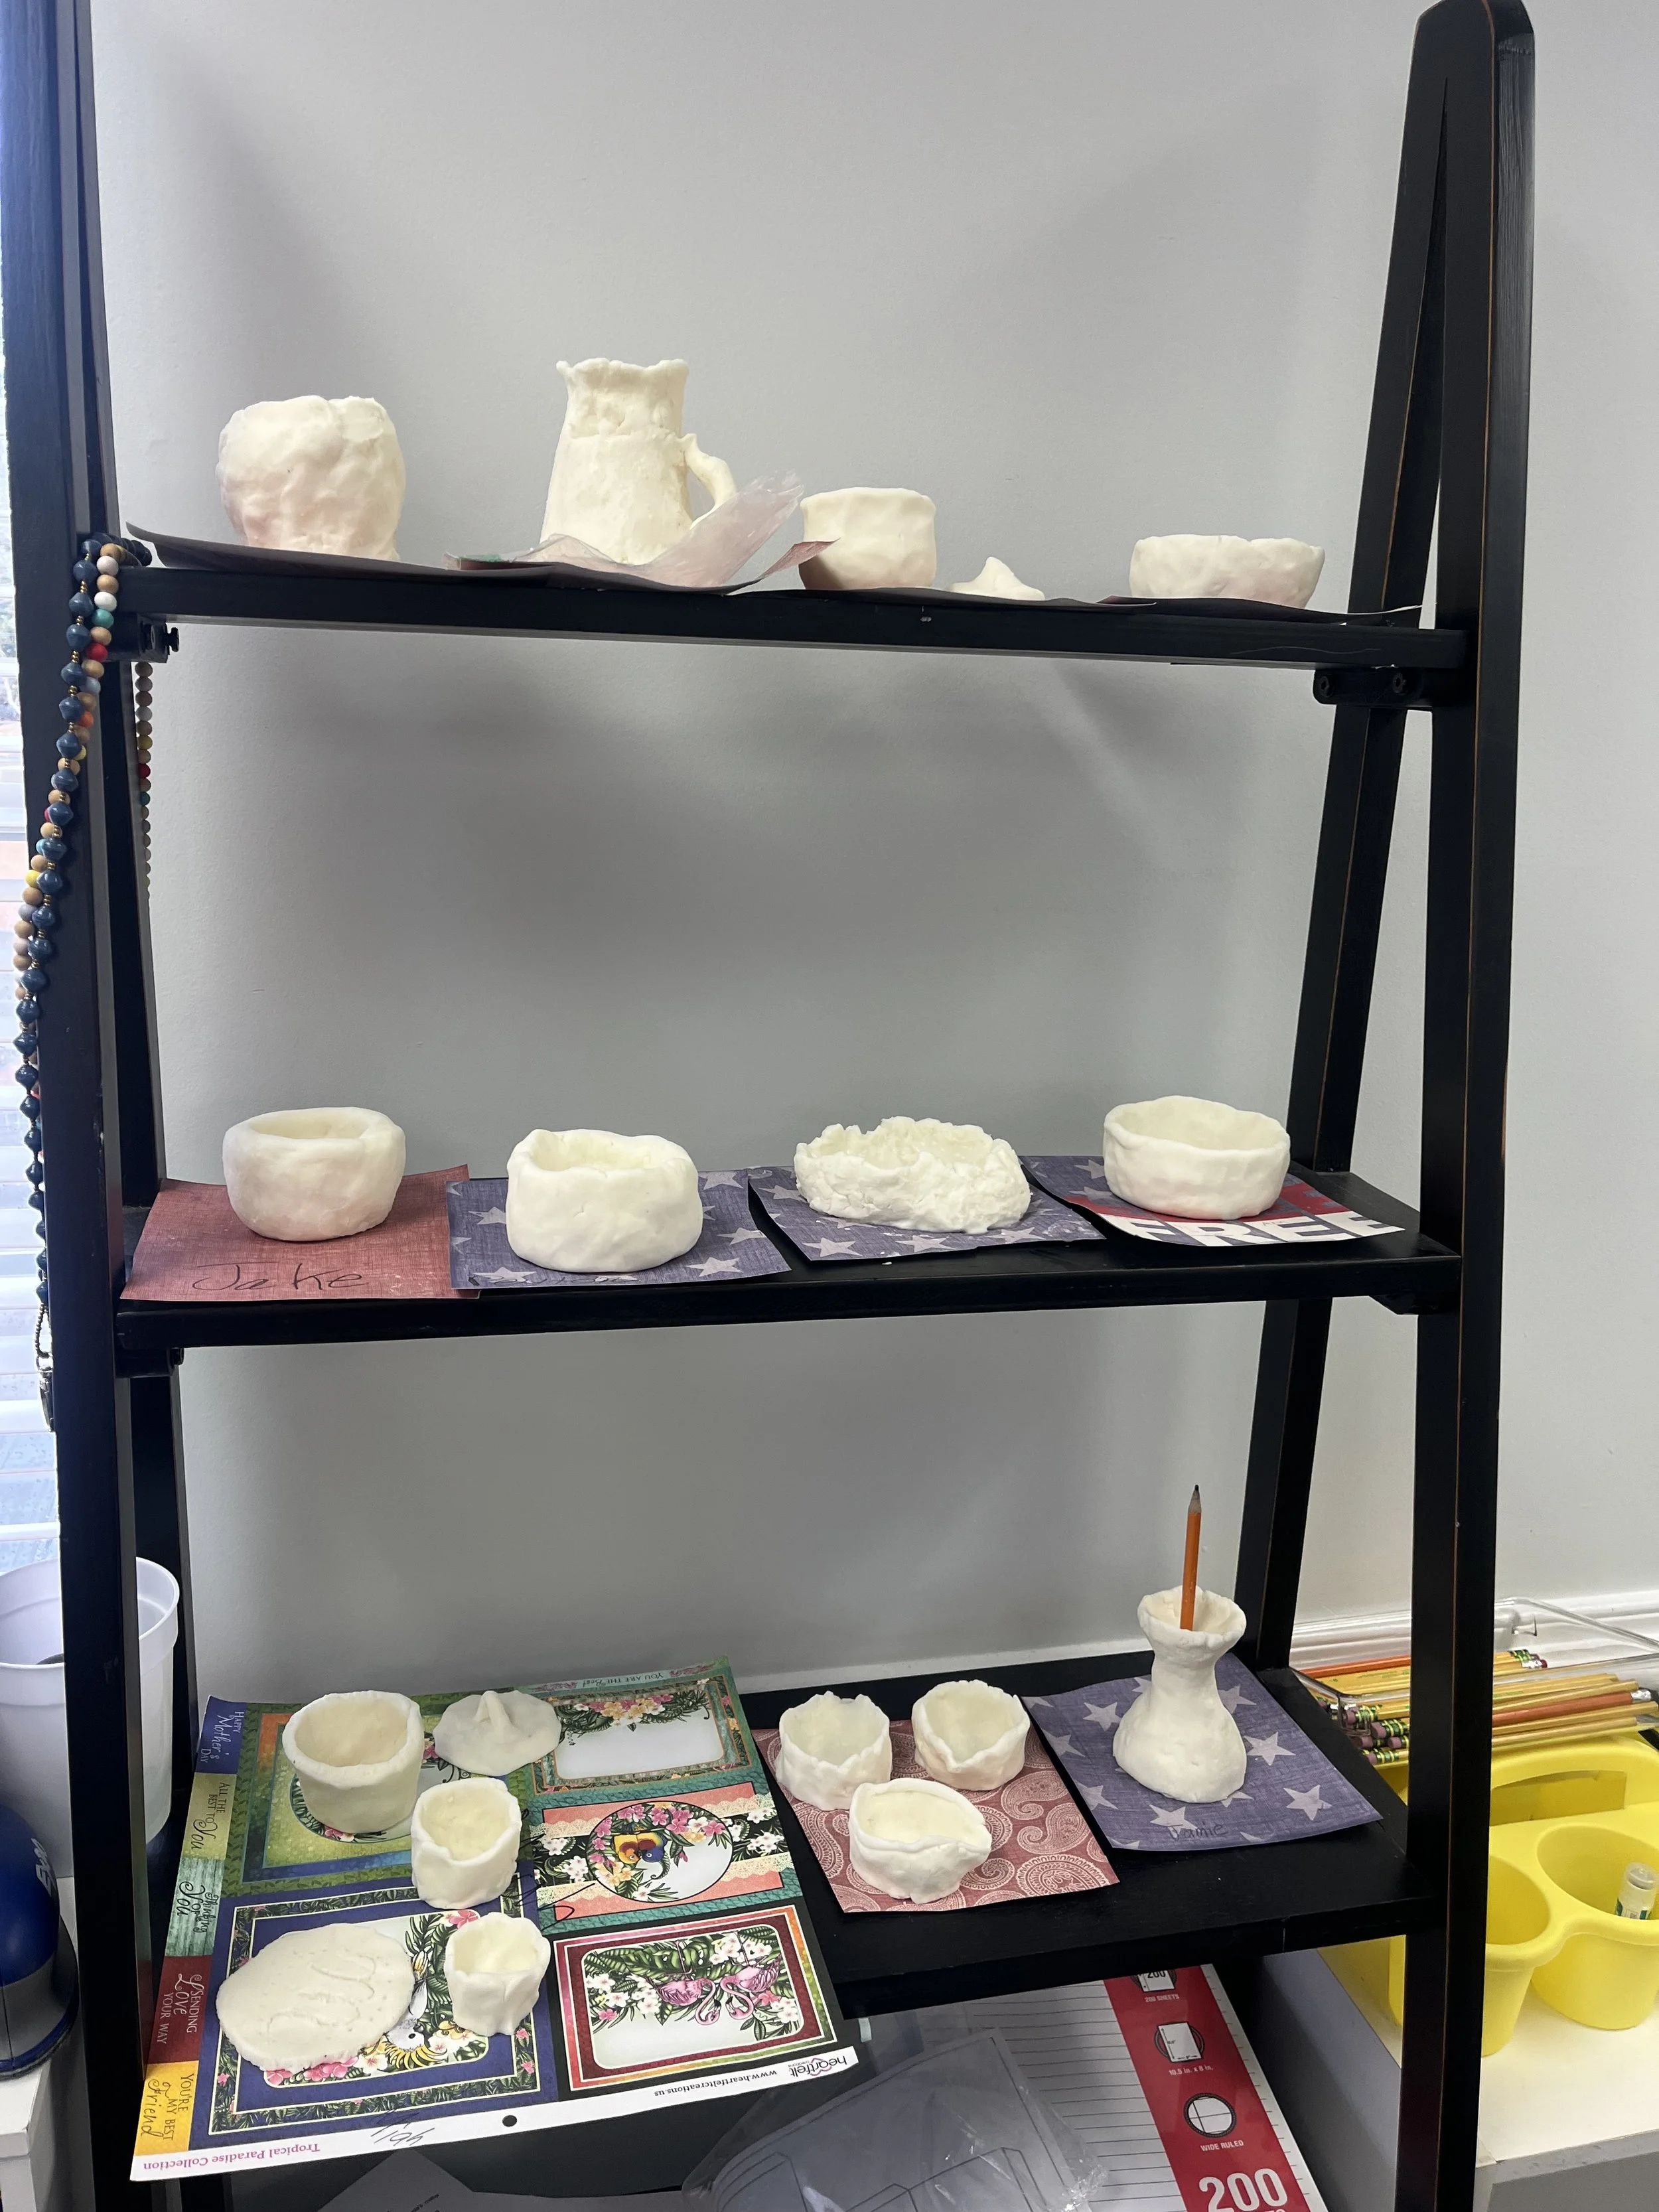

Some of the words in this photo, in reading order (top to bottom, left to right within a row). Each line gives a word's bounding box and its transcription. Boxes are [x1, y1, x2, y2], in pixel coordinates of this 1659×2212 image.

[211, 1714, 234, 1759] Mother's
[200, 1748, 212, 1763] DAY
[218, 1782, 231, 1797] ALL
[207, 1794, 218, 1810] BEST
[216, 1799, 227, 1813] THE
[205, 1812, 216, 1824] TO
[190, 1819, 218, 1850] You
[1168, 1821, 1229, 1842] Jamie
[176, 1881, 206, 1917] You
[192, 1892, 219, 1933] Thinking
[160, 1992, 174, 2019] YOUR
[186, 1990, 204, 2033] SENDING
[157, 2023, 170, 2044] WAY
[789, 2055, 847, 2077] heartfelt
[178, 2073, 194, 2112] YOU'RE
[654, 2070, 777, 2097] www.heartfeltcreations.us
[166, 2099, 178, 2115] MY
[163, 2119, 176, 2140] BEST
[269, 2144, 320, 2158] Tropical
[1200, 2143, 1220, 2152] WIDE
[1221, 2140, 1244, 2150] RULED
[143, 2157, 208, 2170] Collection
[212, 2150, 265, 2164] Paradise
[1198, 2168, 1288, 2212] 200
